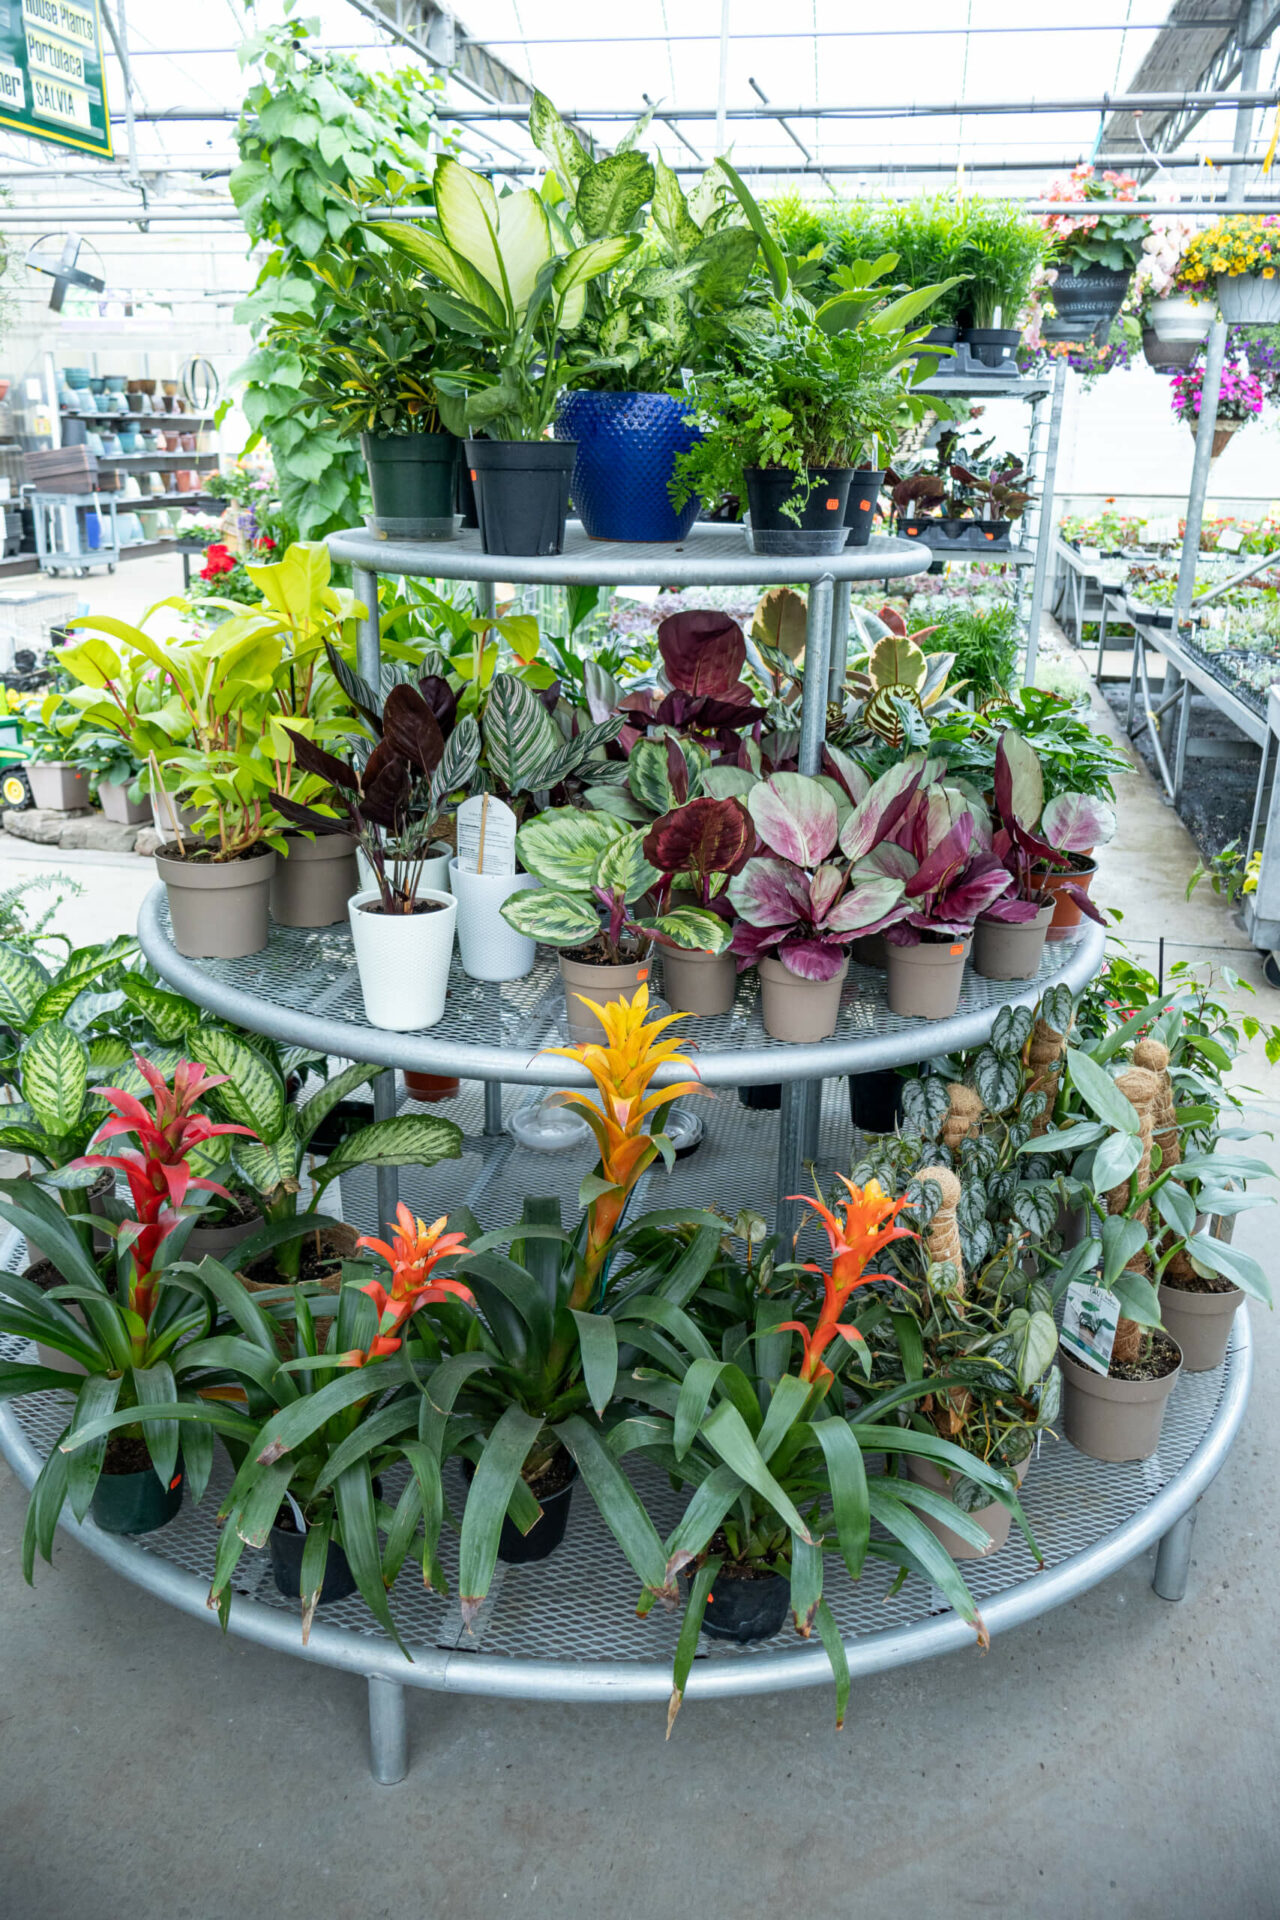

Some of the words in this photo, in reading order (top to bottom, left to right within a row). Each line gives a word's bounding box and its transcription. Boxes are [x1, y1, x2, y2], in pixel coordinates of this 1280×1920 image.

[60, 4, 93, 40] Plants
[28, 33, 82, 78] Portulaca
[35, 80, 76, 116] SALVIA
